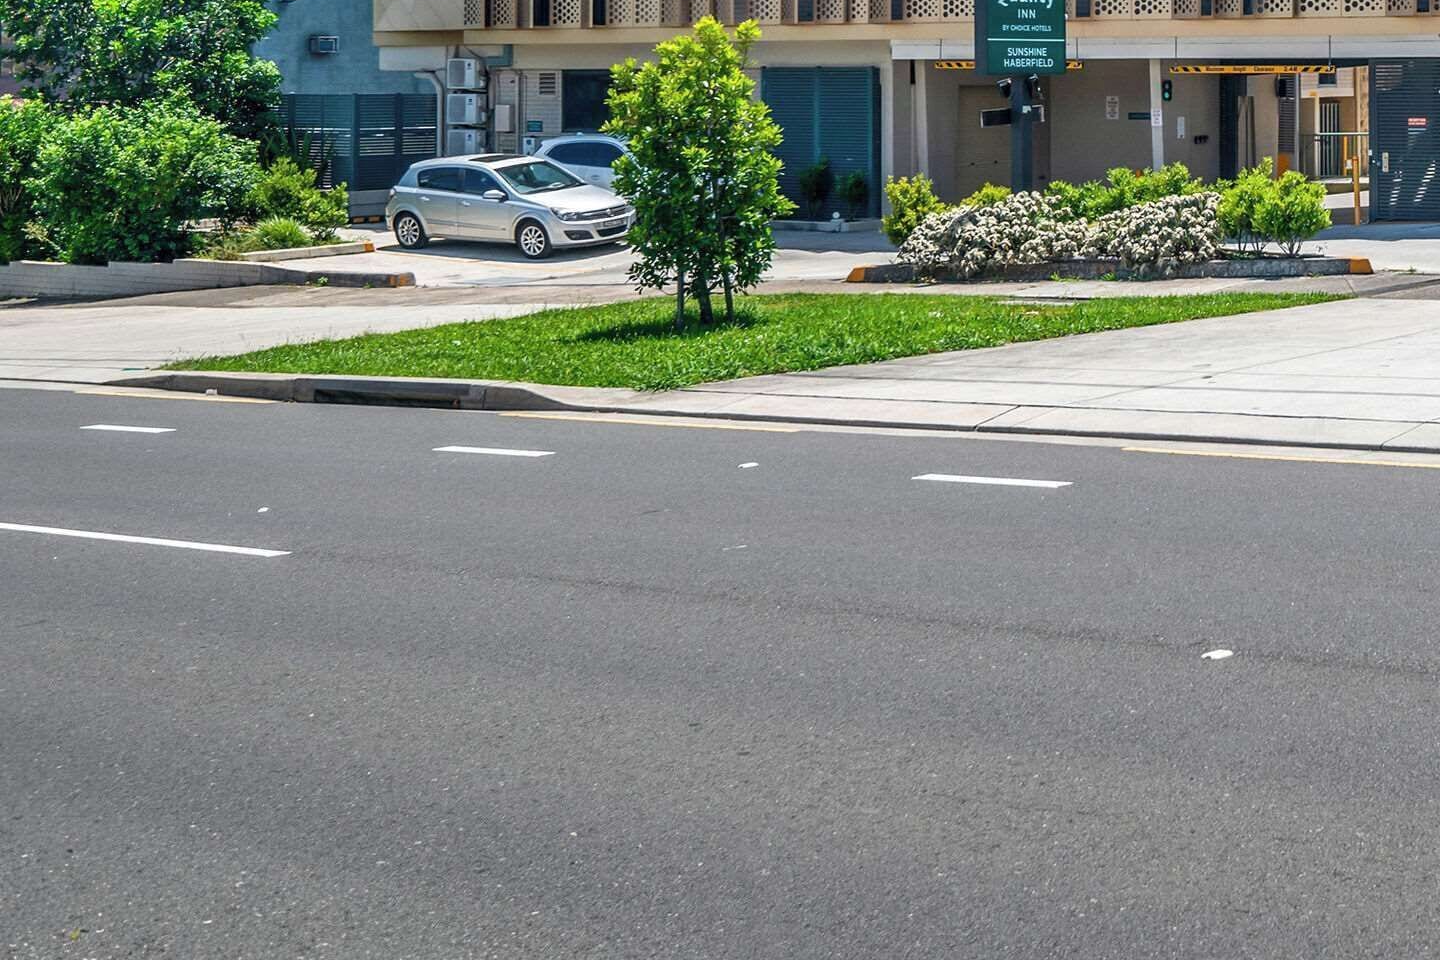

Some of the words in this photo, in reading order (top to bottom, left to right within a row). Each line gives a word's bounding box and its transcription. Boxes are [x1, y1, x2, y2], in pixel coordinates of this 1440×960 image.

[1017, 8, 1036, 19] INN
[1031, 24, 1052, 32] HOTELS
[1007, 47, 1047, 57] SUNSHINE
[1003, 58, 1054, 68] HABERFIELD
